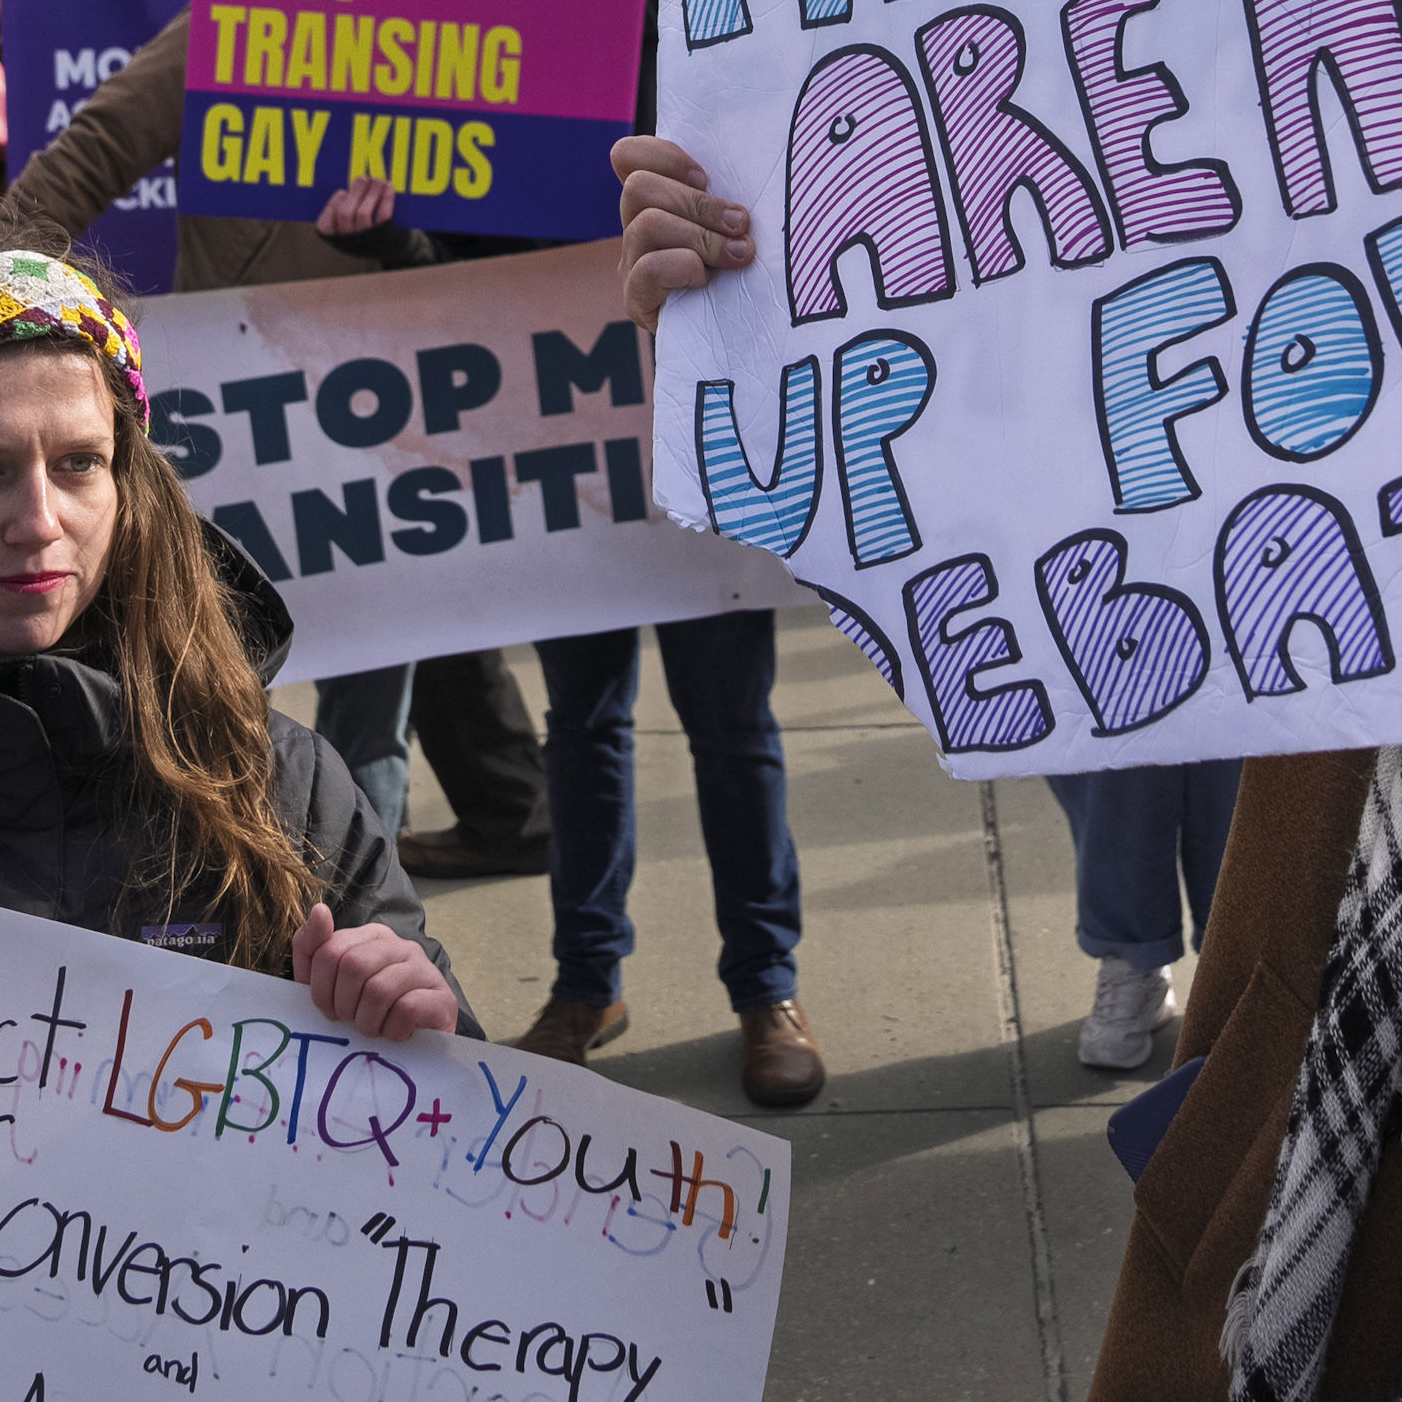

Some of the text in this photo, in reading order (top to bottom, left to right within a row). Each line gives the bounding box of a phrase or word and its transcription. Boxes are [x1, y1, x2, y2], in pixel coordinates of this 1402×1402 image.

[210, 4, 523, 104] TRANSING
[201, 102, 331, 188] GAY
[349, 113, 496, 200] KIDS
[149, 343, 503, 481] STOP
[694, 328, 937, 569] UP
[101, 988, 453, 1168] LGBTQ+
[143, 1351, 199, 1394] and
